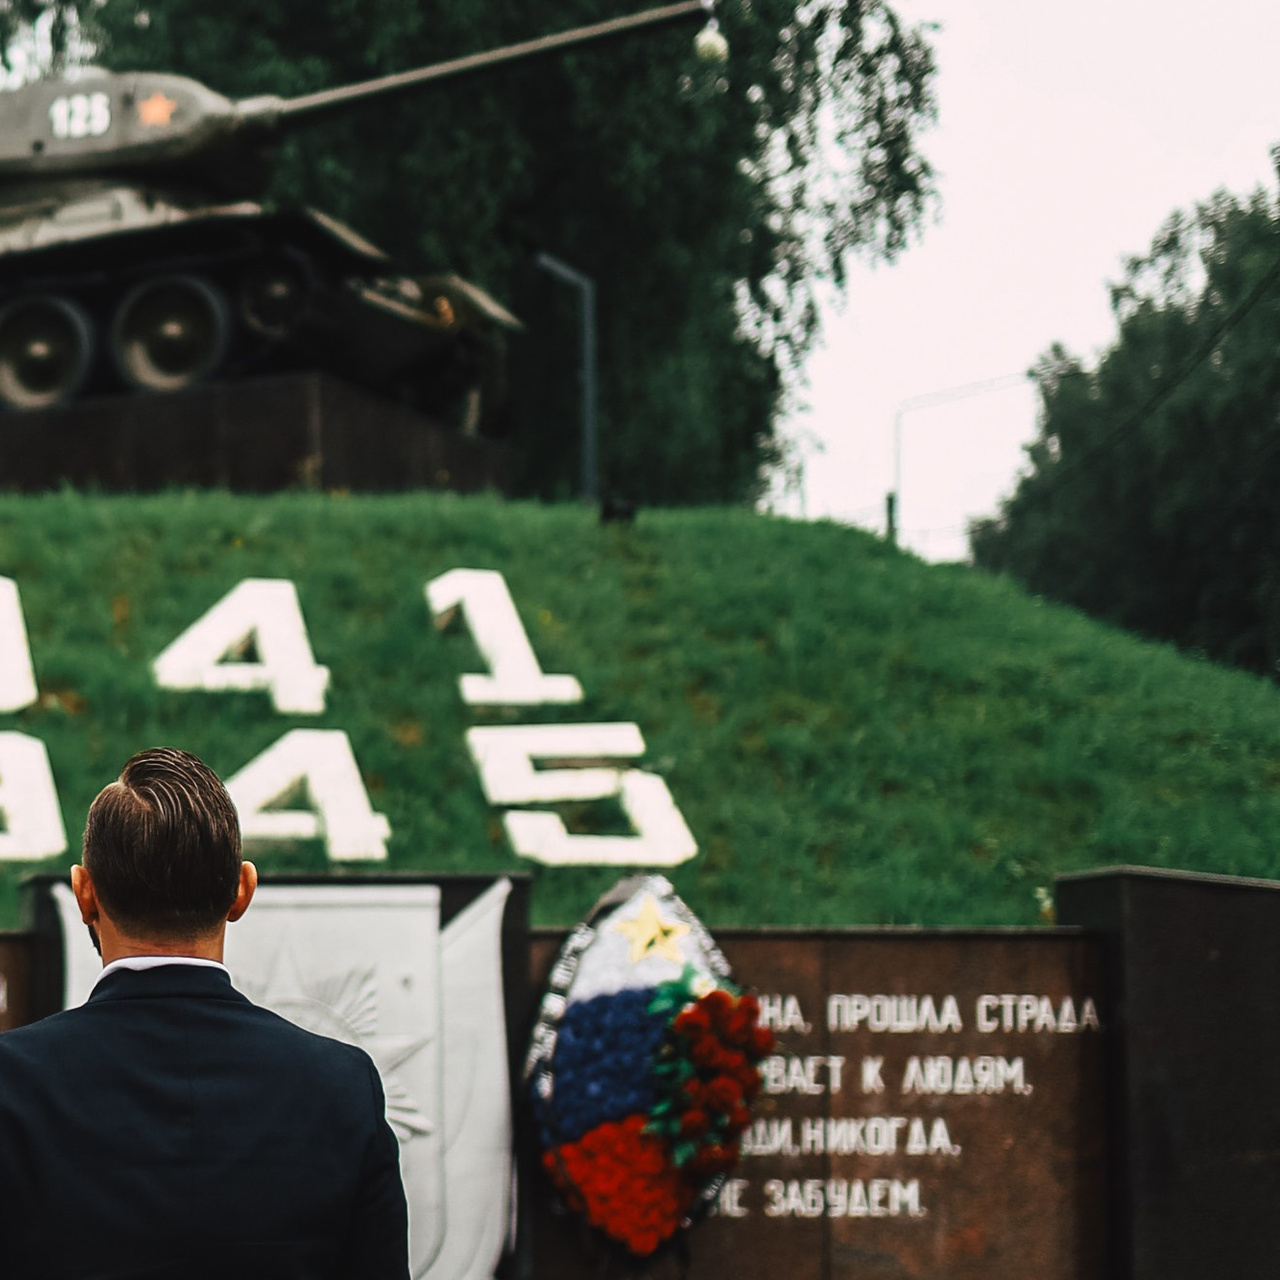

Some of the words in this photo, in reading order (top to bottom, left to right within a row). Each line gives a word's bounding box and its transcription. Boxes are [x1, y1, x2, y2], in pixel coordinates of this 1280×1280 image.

[757, 992, 812, 1036] НА,
[825, 992, 962, 1034] ПРОШЛА
[757, 1054, 846, 1095] ВАЕТ
[862, 1055, 886, 1095] К
